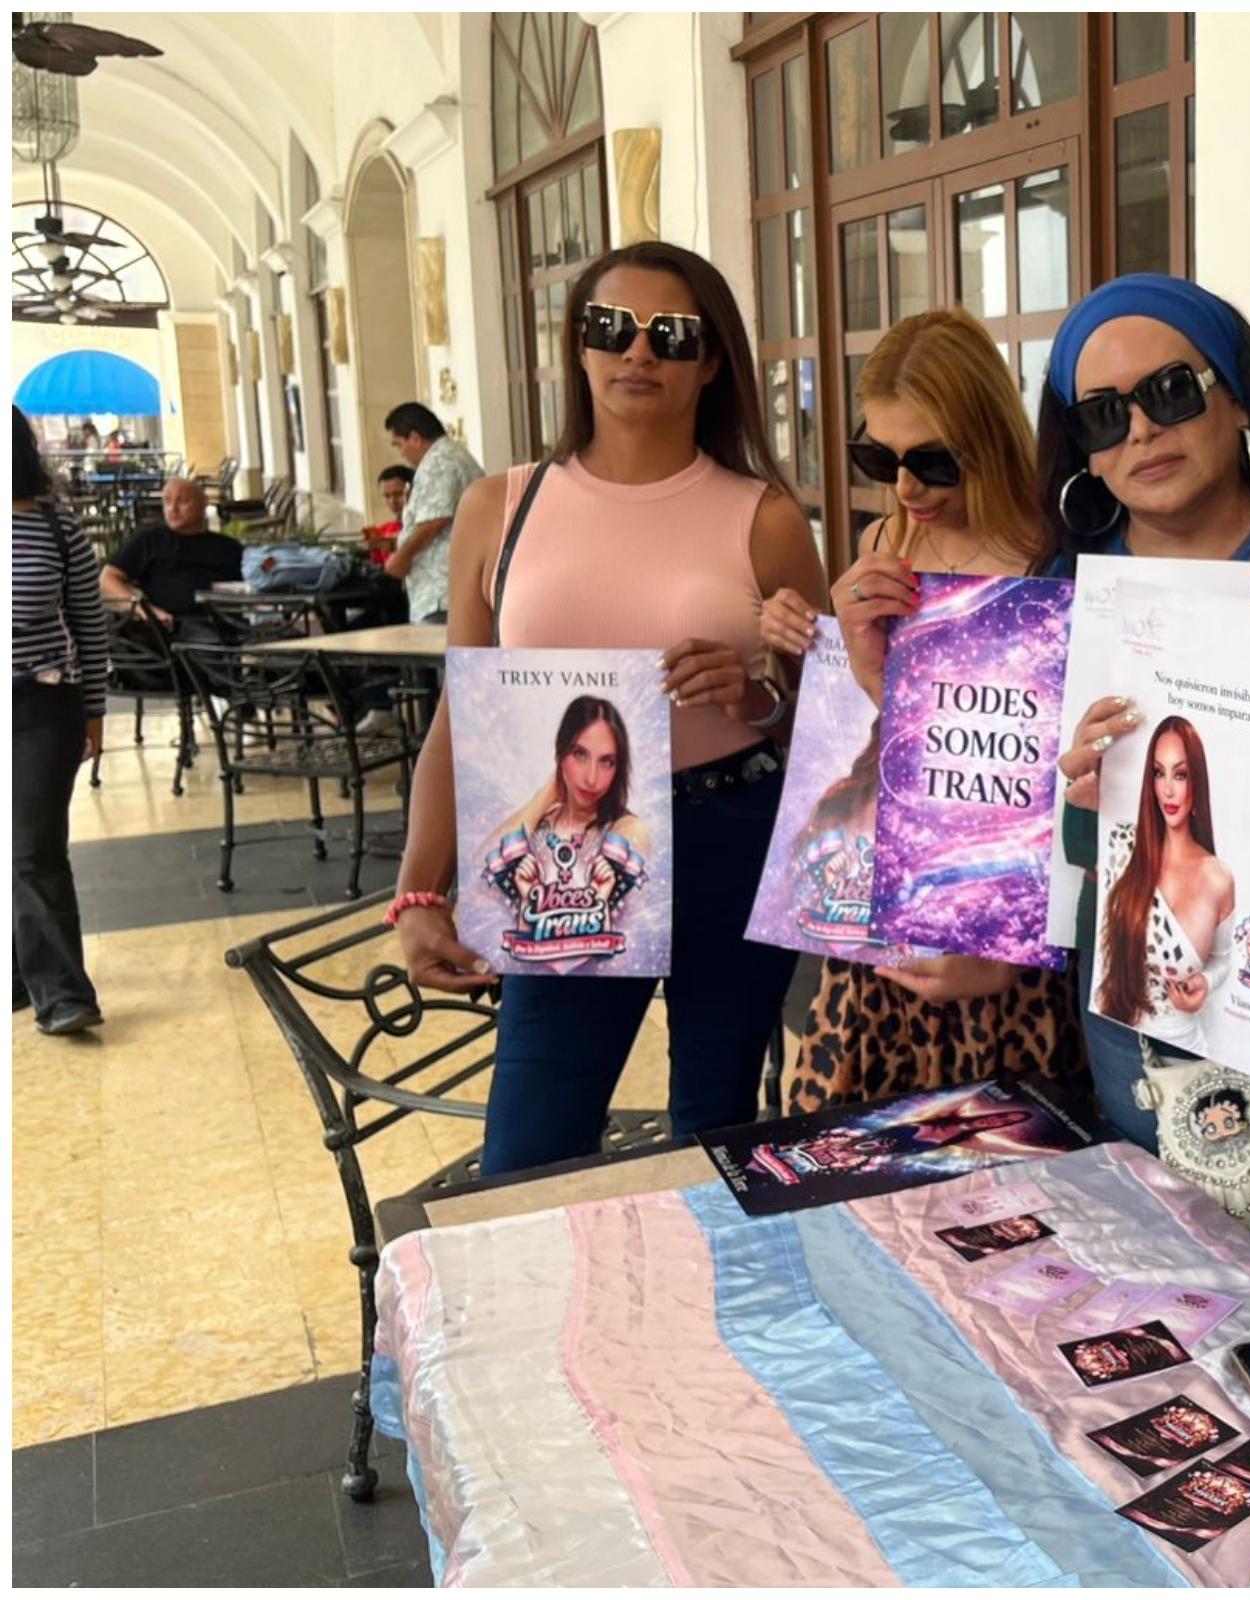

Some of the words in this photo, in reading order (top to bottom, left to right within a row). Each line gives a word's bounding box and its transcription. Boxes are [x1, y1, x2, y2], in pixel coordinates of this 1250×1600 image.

[498, 669, 553, 687] TRIXY
[560, 670, 619, 688] VANIE
[931, 680, 1038, 719] TODES
[925, 724, 1041, 765] SOMOS
[922, 766, 1032, 809] TRANS
[529, 881, 595, 912] Voces
[523, 900, 604, 942] Trans
